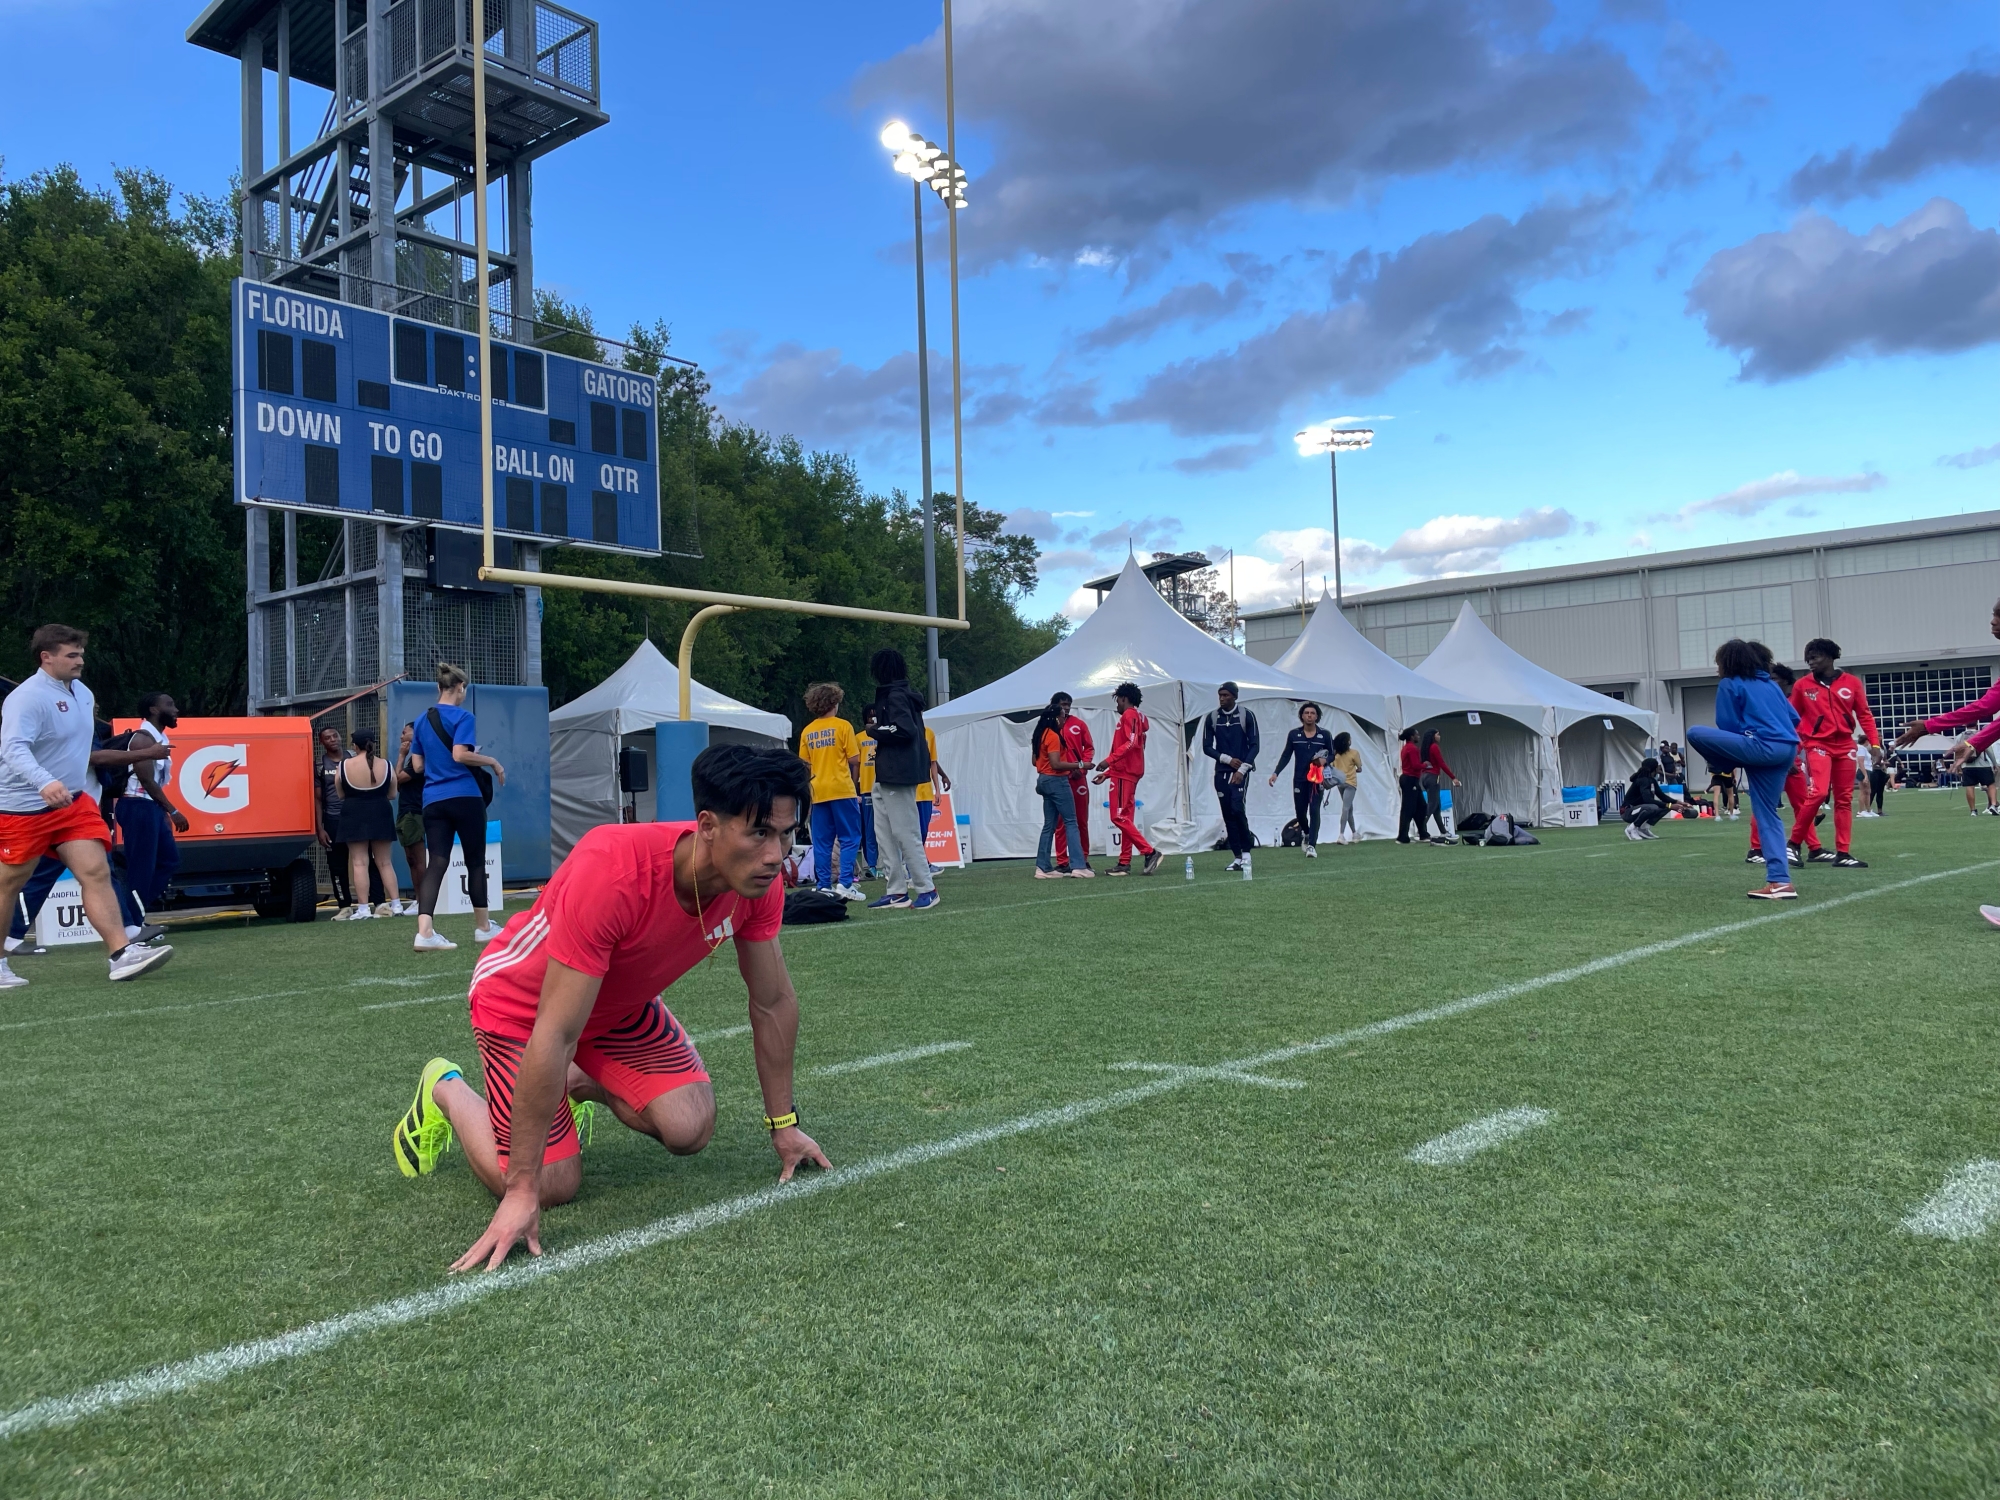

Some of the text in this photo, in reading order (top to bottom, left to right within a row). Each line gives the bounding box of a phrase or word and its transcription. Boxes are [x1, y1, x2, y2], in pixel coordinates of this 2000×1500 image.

[248, 289, 344, 339] FLORIDA
[440, 387, 506, 407] DAKTROCS
[584, 368, 652, 408] GATORS
[257, 402, 341, 444] DOWN
[368, 421, 443, 461] TO GO
[495, 444, 575, 484] BALL ON
[600, 463, 639, 494] QTR
[806, 728, 836, 741] TOO FAST
[815, 737, 835, 748] CHASE
[178, 743, 250, 814] G
[1569, 810, 1582, 820] UF
[925, 840, 947, 848] TENT
[47, 890, 80, 899] LANDFILL
[58, 929, 94, 938] FLORIDA
